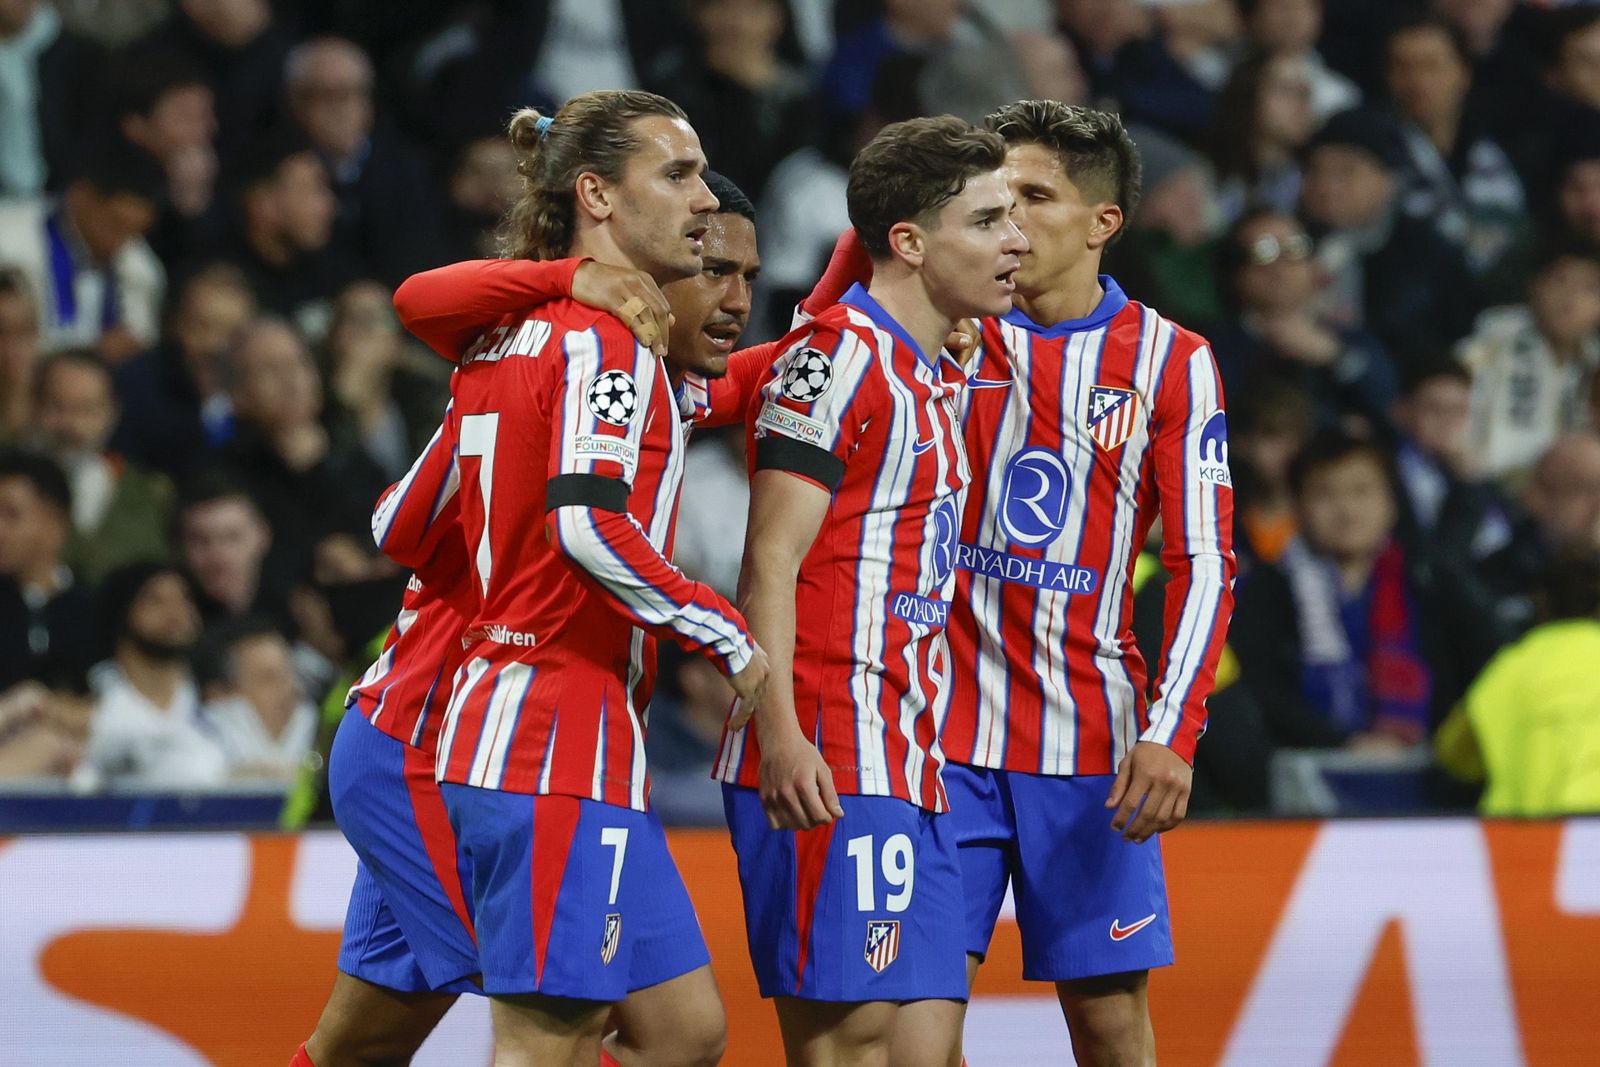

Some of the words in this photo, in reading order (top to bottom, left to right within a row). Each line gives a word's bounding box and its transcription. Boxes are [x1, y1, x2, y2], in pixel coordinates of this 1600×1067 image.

[575, 442, 634, 460] FOUNDATION
[459, 412, 500, 600] 7
[956, 544, 1045, 585] RIYADH
[1050, 568, 1092, 592] AIR
[894, 594, 947, 623] RIYADH
[601, 828, 629, 905] 7
[847, 833, 915, 912] 19
